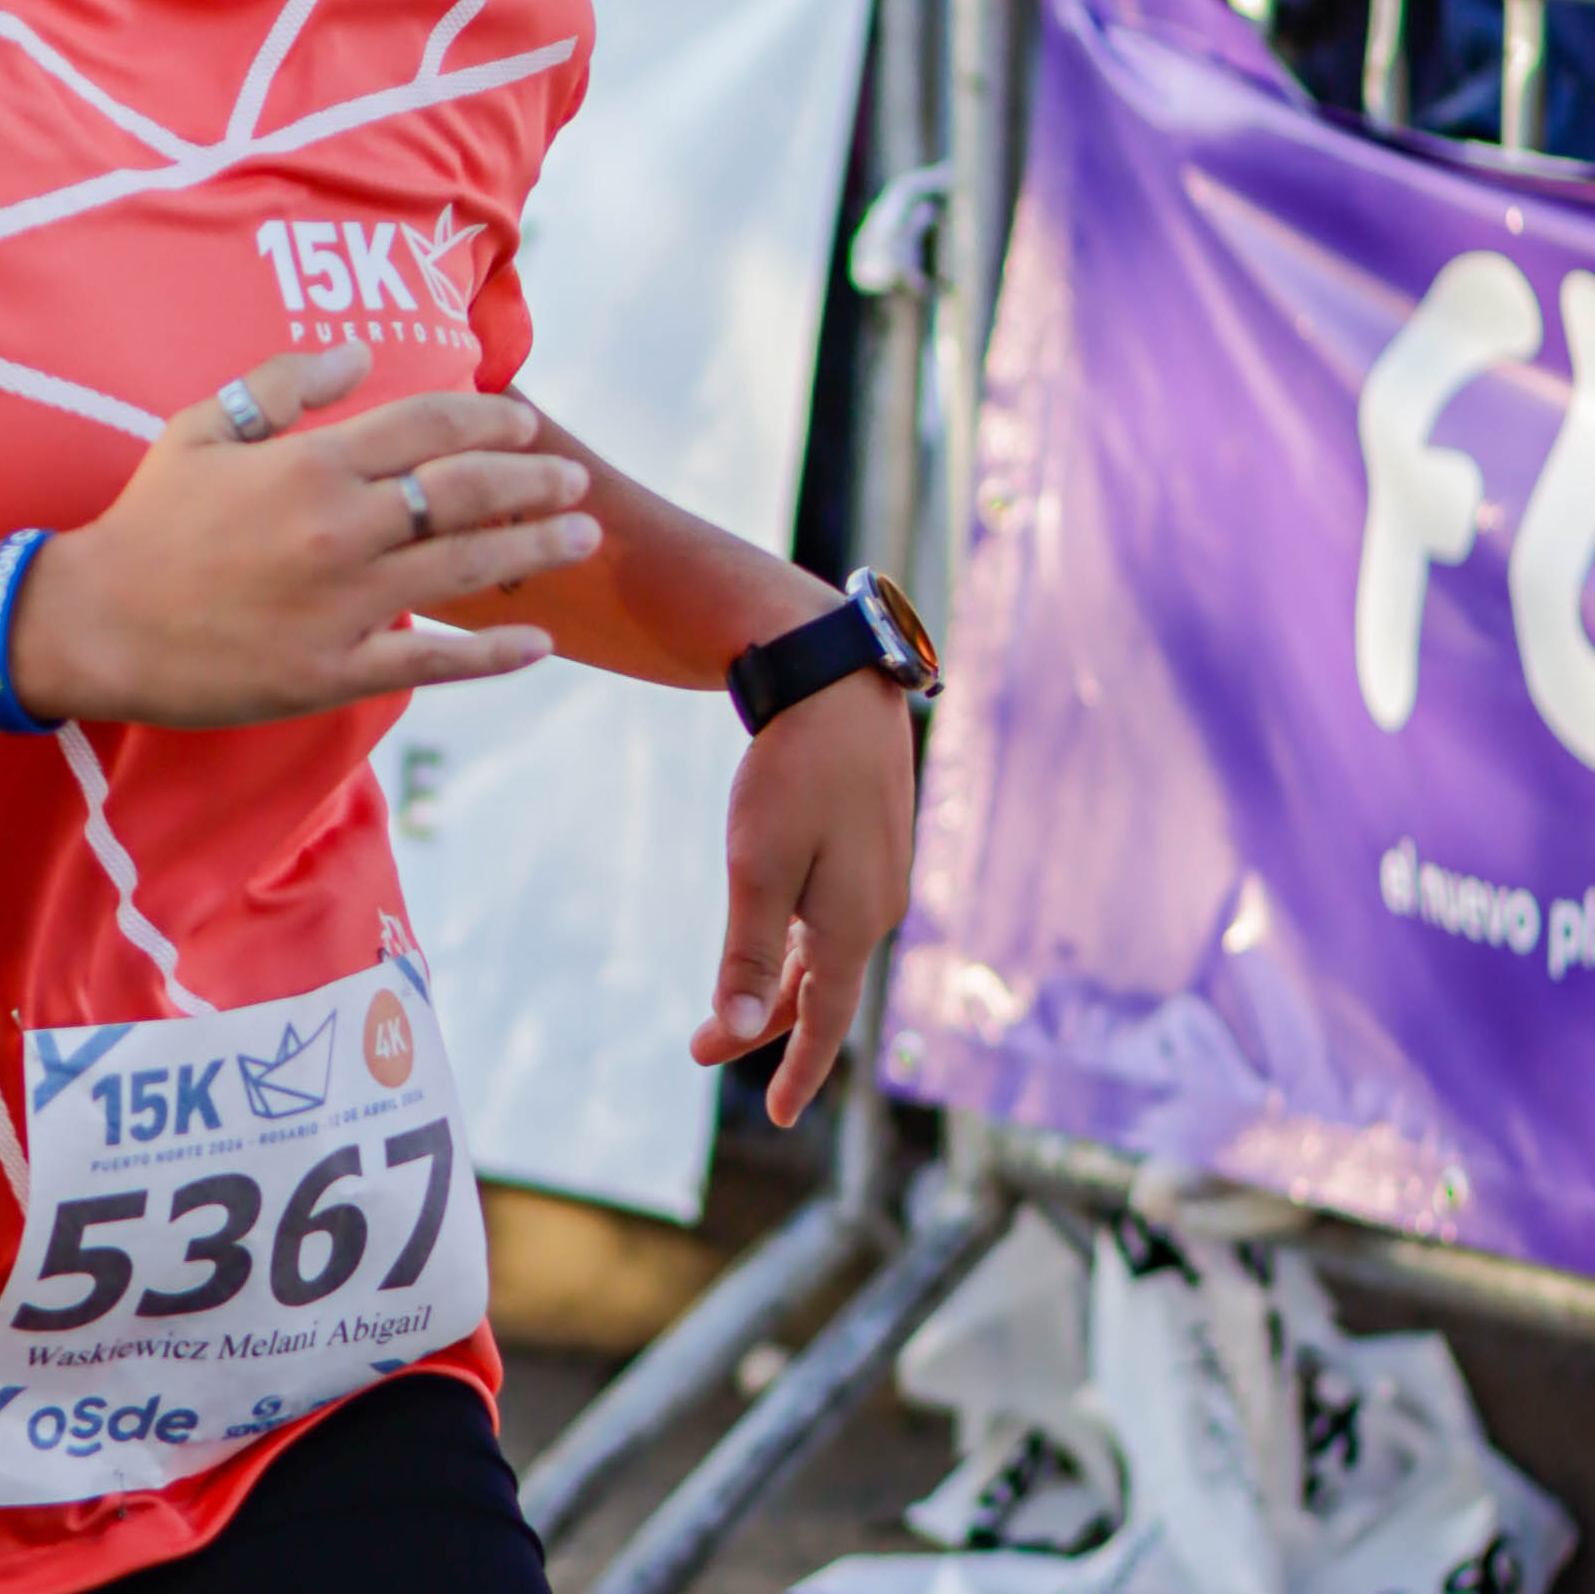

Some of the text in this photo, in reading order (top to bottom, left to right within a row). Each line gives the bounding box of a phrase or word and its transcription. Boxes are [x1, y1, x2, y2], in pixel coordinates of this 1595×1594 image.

[256, 219, 418, 312] 15K
[290, 320, 427, 344] PUERTO
[374, 1016, 408, 1060] 4K
[90, 1057, 226, 1146] 15K
[90, 1152, 151, 1173] PUERTO
[156, 1143, 204, 1163] NORTE
[259, 1121, 319, 1145] ROSARIO
[10, 1117, 454, 1332] 5367
[28, 1304, 433, 1366] Waskiewicz Melani Abigail
